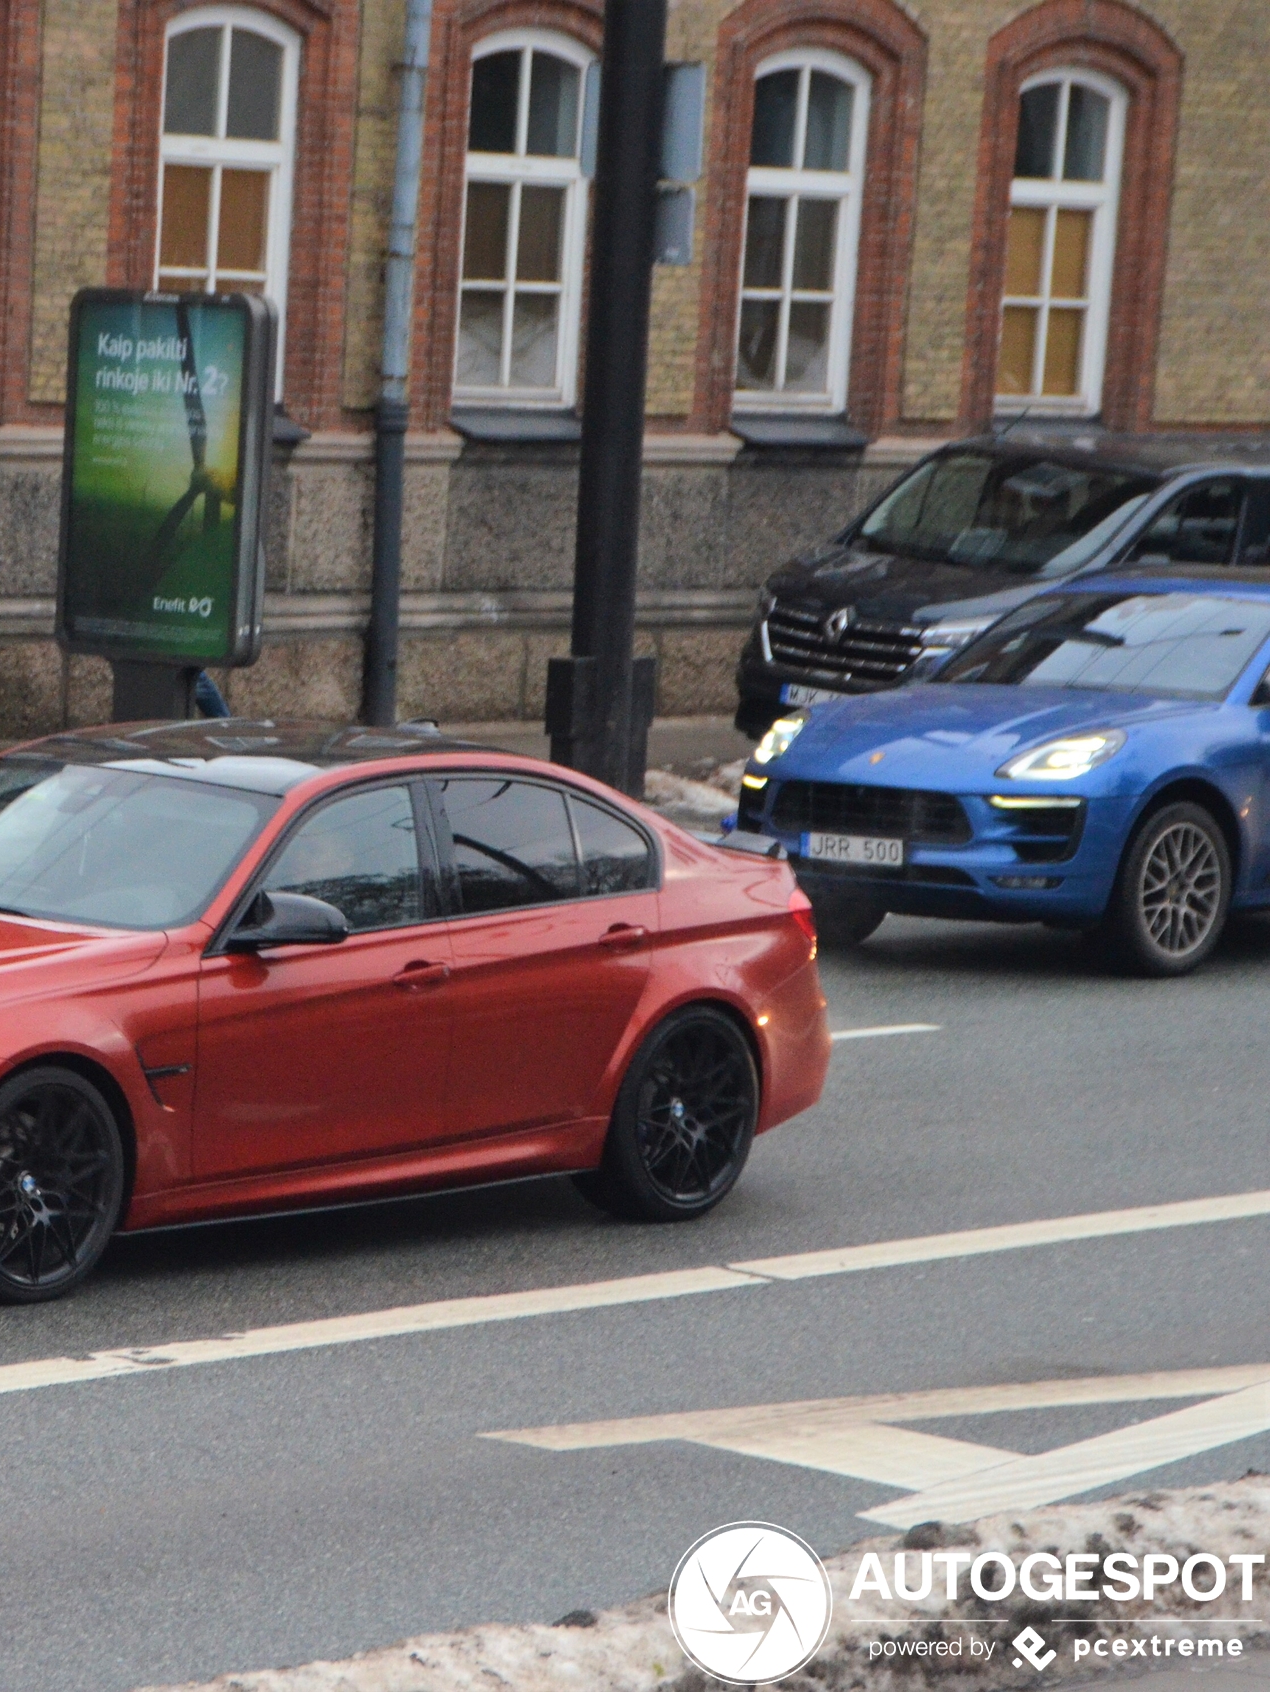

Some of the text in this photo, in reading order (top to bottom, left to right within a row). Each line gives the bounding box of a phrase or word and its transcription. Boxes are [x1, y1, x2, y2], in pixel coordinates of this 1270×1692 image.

[97, 332, 188, 363] Kaip pakilti
[95, 366, 149, 396] rinkoje
[152, 369, 171, 392] iki
[174, 370, 198, 394] Nr.
[812, 836, 900, 861] JRR 500
